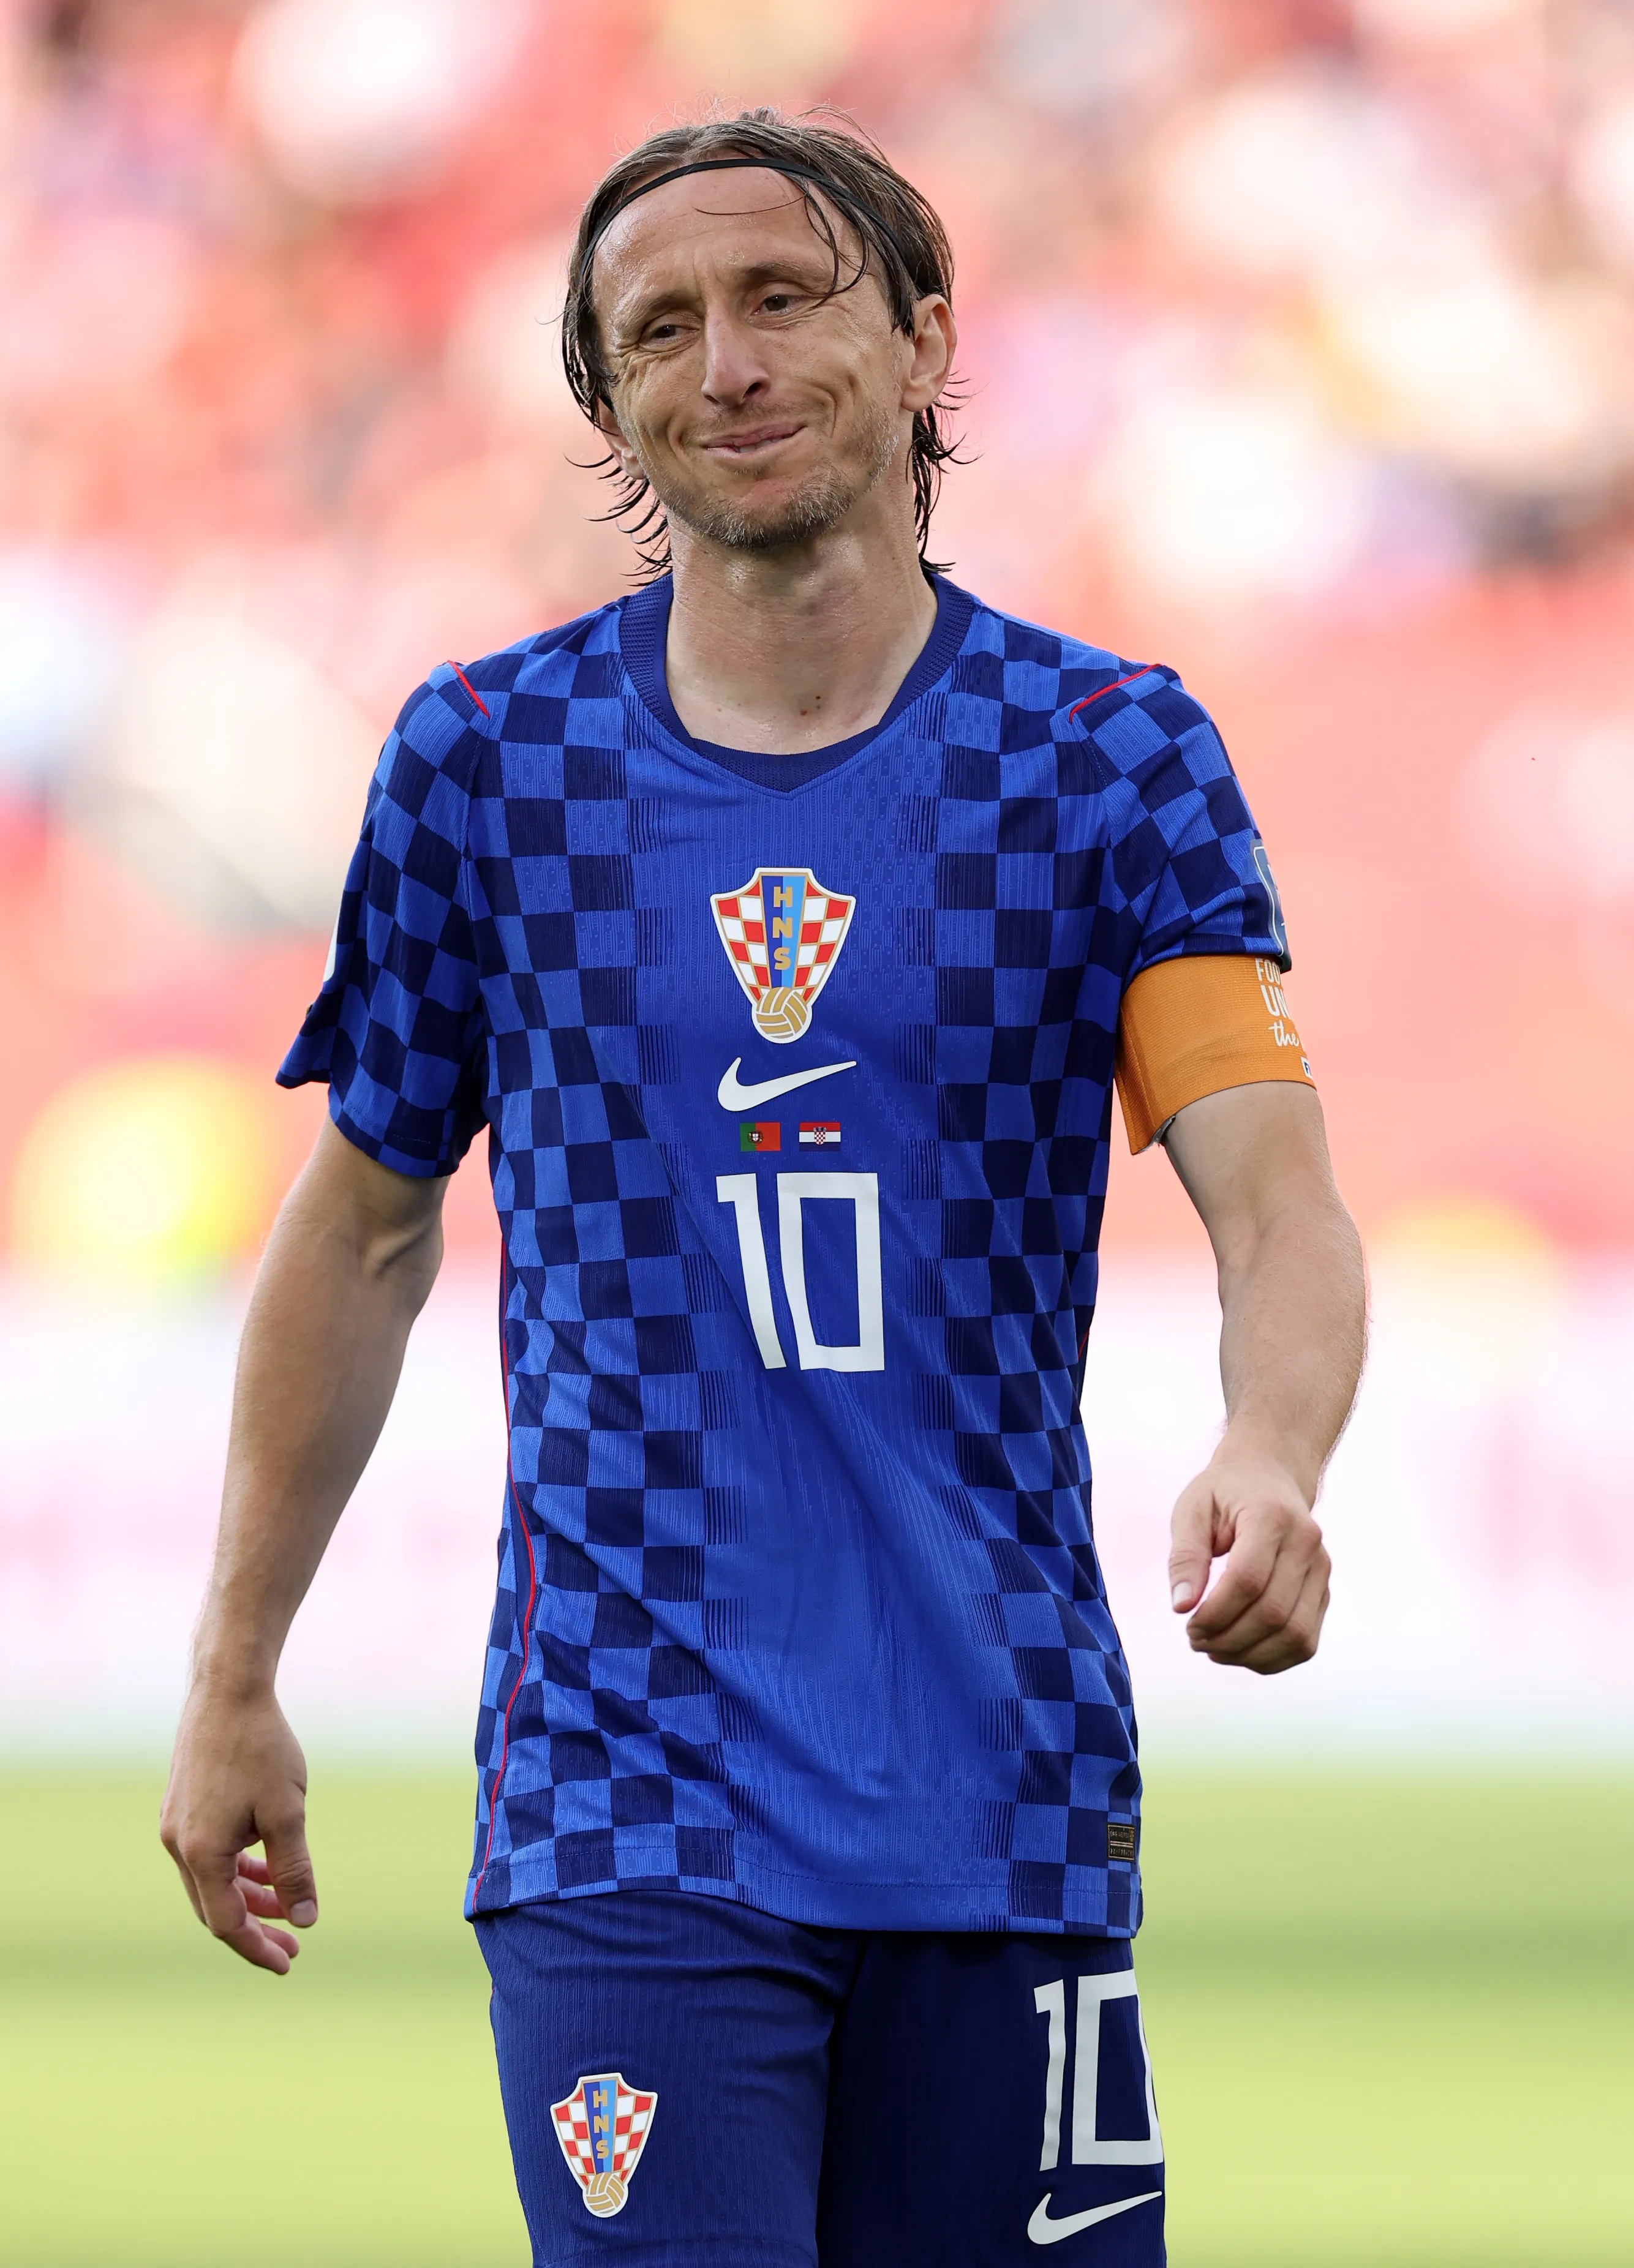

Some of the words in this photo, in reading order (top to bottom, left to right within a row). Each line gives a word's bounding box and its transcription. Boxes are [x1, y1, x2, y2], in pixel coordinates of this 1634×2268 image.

[772, 886, 793, 971] HNS
[1268, 1019, 1300, 1047] the
[715, 1172, 885, 1372] 10
[1033, 1969, 1164, 2171] 10
[592, 2089, 609, 2159] HNS
